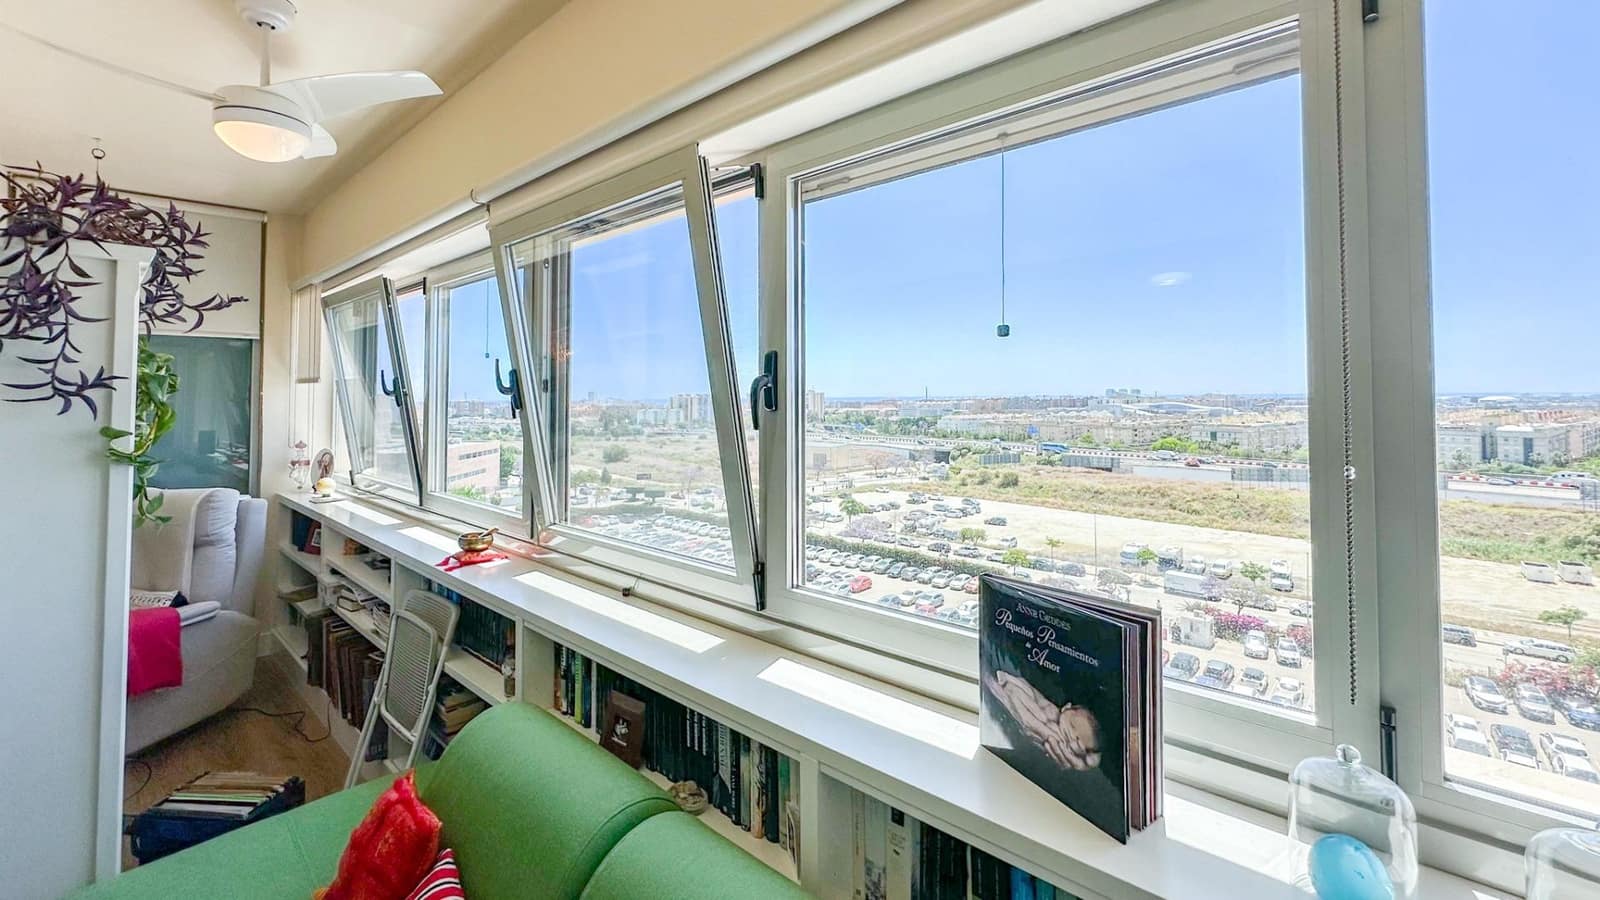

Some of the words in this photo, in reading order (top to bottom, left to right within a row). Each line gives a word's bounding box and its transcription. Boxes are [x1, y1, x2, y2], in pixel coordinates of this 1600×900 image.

[995, 608, 1035, 639] Pequeños
[1036, 625, 1100, 667] Pensamientos
[1027, 648, 1062, 673] Amor
